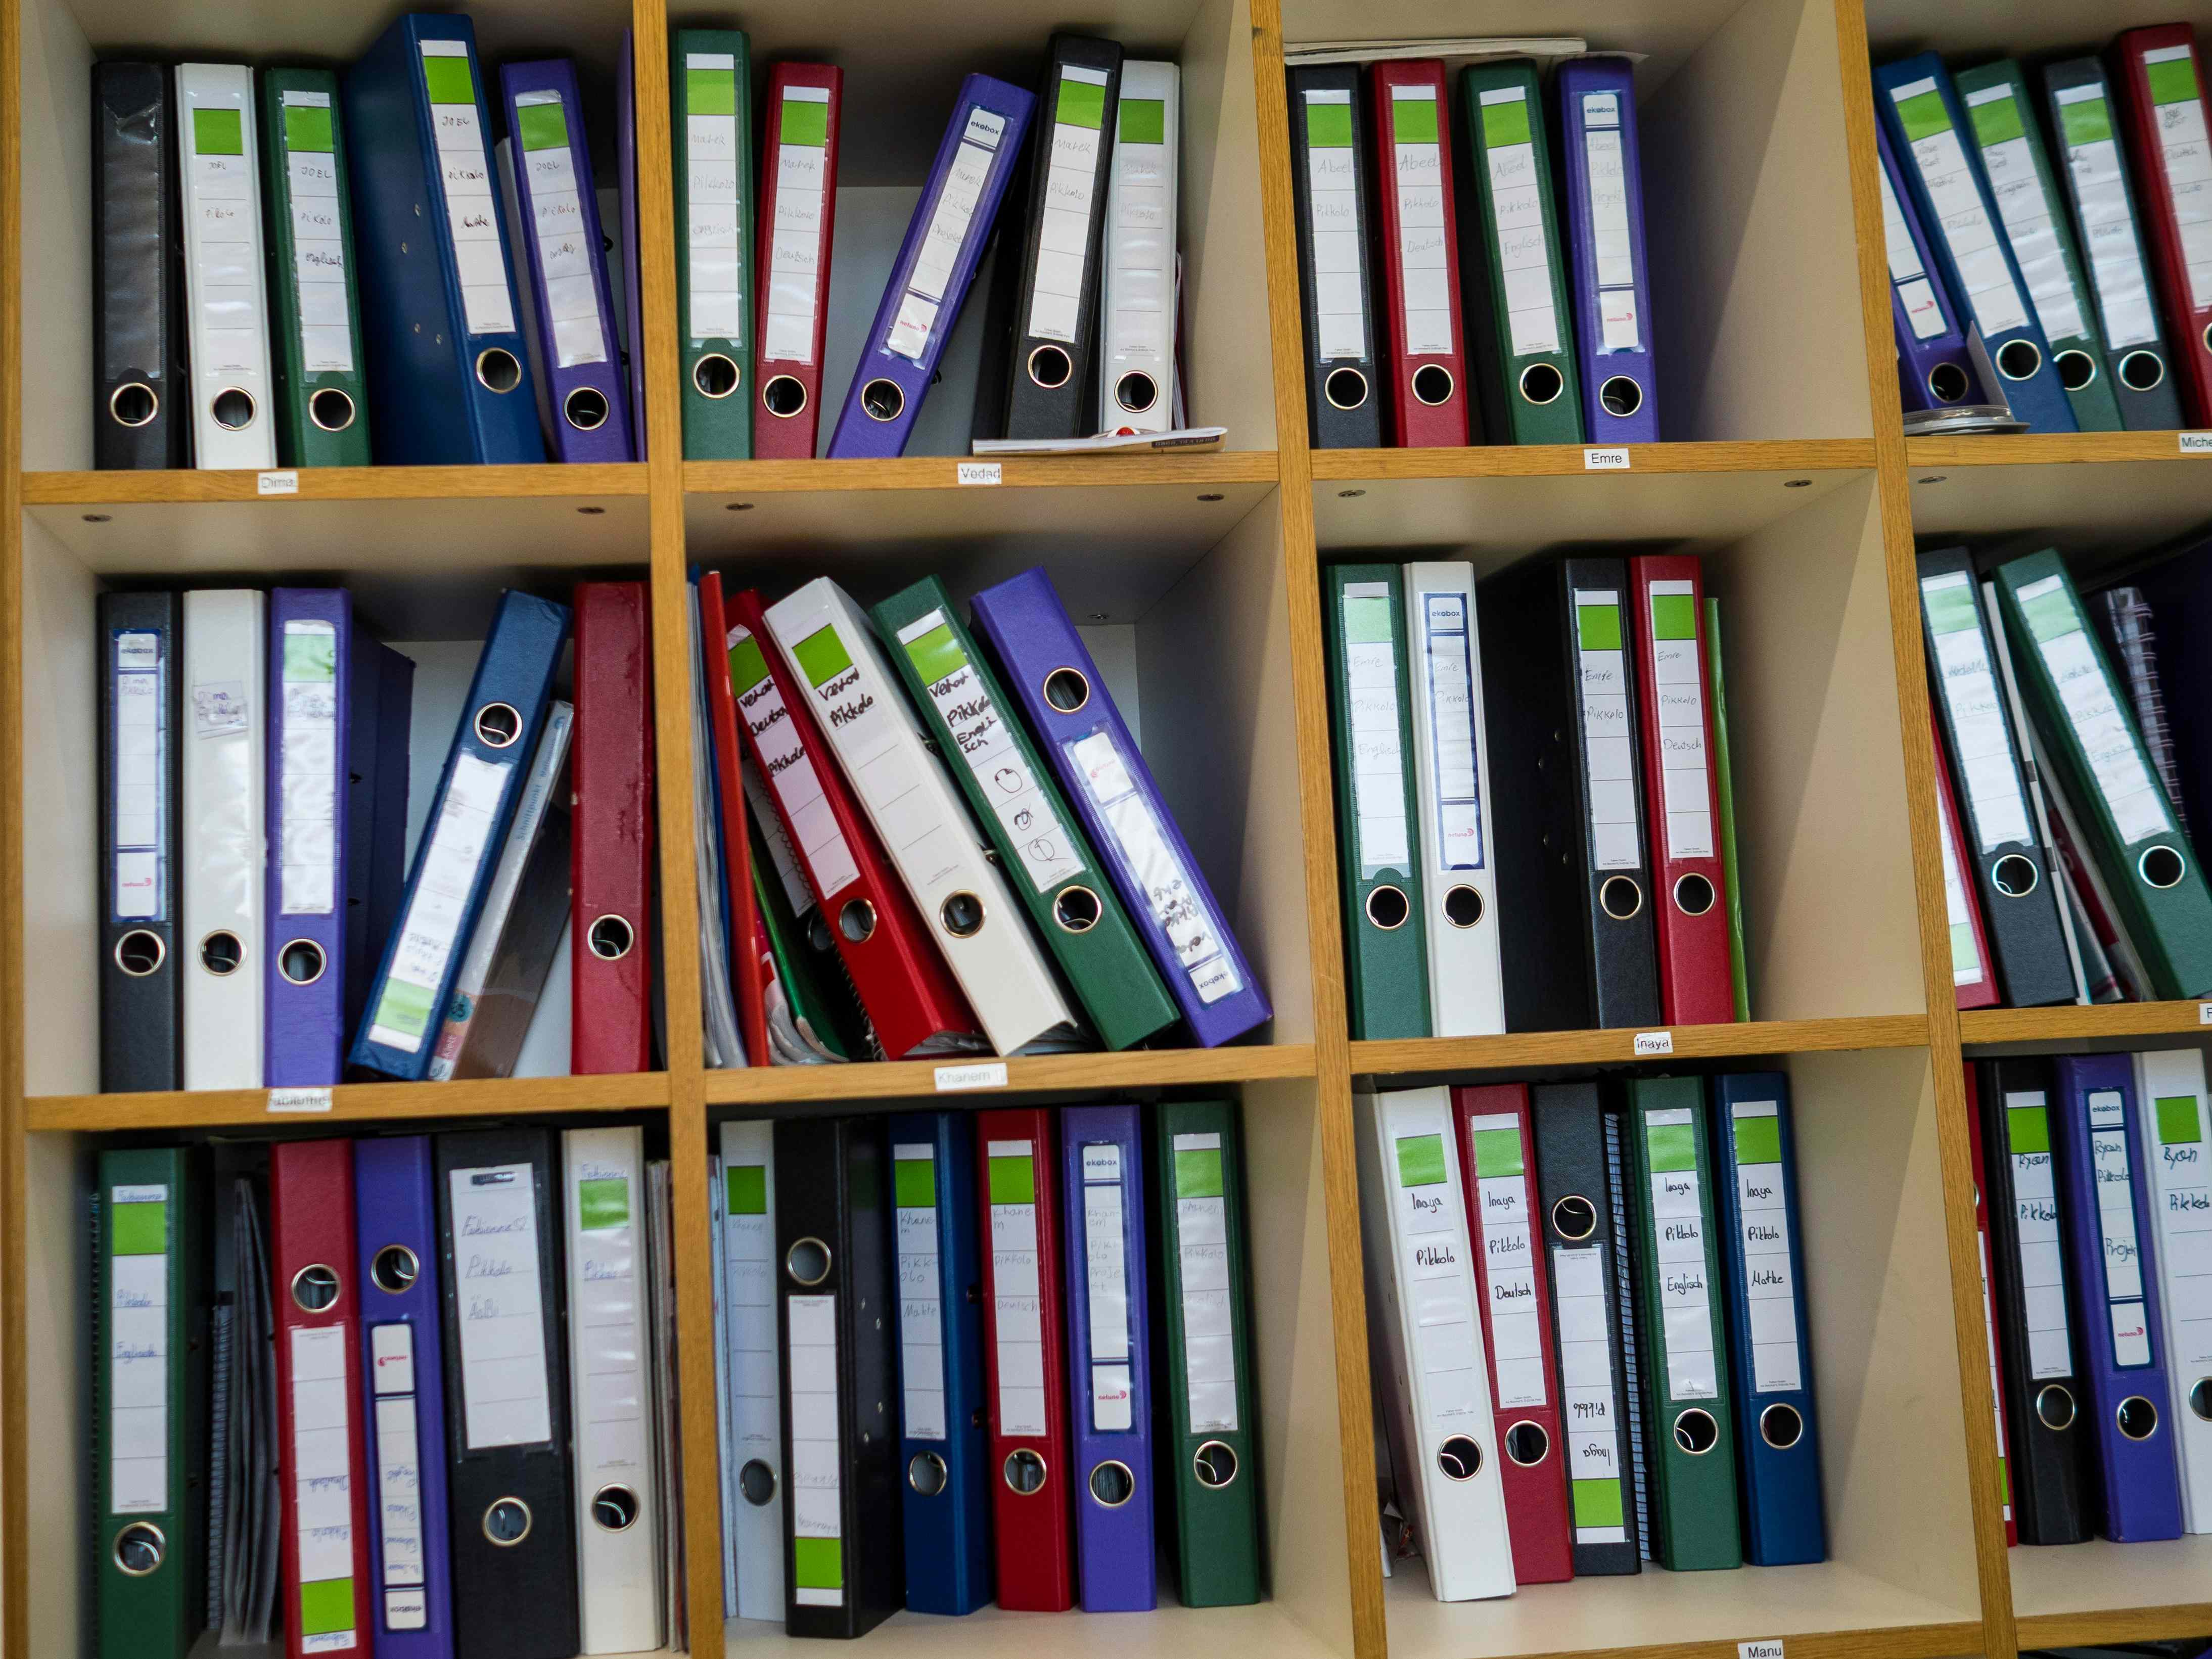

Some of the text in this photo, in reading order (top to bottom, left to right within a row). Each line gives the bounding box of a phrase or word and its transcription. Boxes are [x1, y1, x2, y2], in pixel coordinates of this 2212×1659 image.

[1399, 153, 1442, 171] Abed
[300, 166, 333, 179] JOEL
[1591, 452, 1622, 464] Emre
[961, 467, 1001, 479] Vedad
[1353, 656, 1384, 668] Emre
[1657, 651, 1682, 661] Emre
[1435, 662, 1460, 673] Emre
[1585, 670, 1614, 681] Emre
[1661, 695, 1697, 706] Pikkolo
[830, 693, 874, 728] Pikkolo
[1587, 706, 1624, 721] Pikkolo
[1663, 738, 1702, 751] Deutsch
[2018, 1154, 2049, 1168] Ryan
[2163, 1146, 2198, 1170] Ryan
[1746, 1179, 1773, 1198] Inaya
[1411, 1192, 1444, 1213] Inaya
[1488, 1191, 1516, 1210] Inaya
[1666, 1225, 1698, 1240] Pikkolo
[1747, 1225, 1780, 1241] Pikkolo
[1489, 1235, 1526, 1255] Pikkolo
[1416, 1246, 1455, 1267] Pikkolo
[1667, 1274, 1703, 1295] Englisch
[1751, 1270, 1784, 1287] Mathe
[1495, 1282, 1532, 1300] Deutsch
[1573, 1400, 1606, 1419] Pikkolo
[1582, 1443, 1611, 1466] Inaya
[1747, 1646, 1781, 1658] Manu
